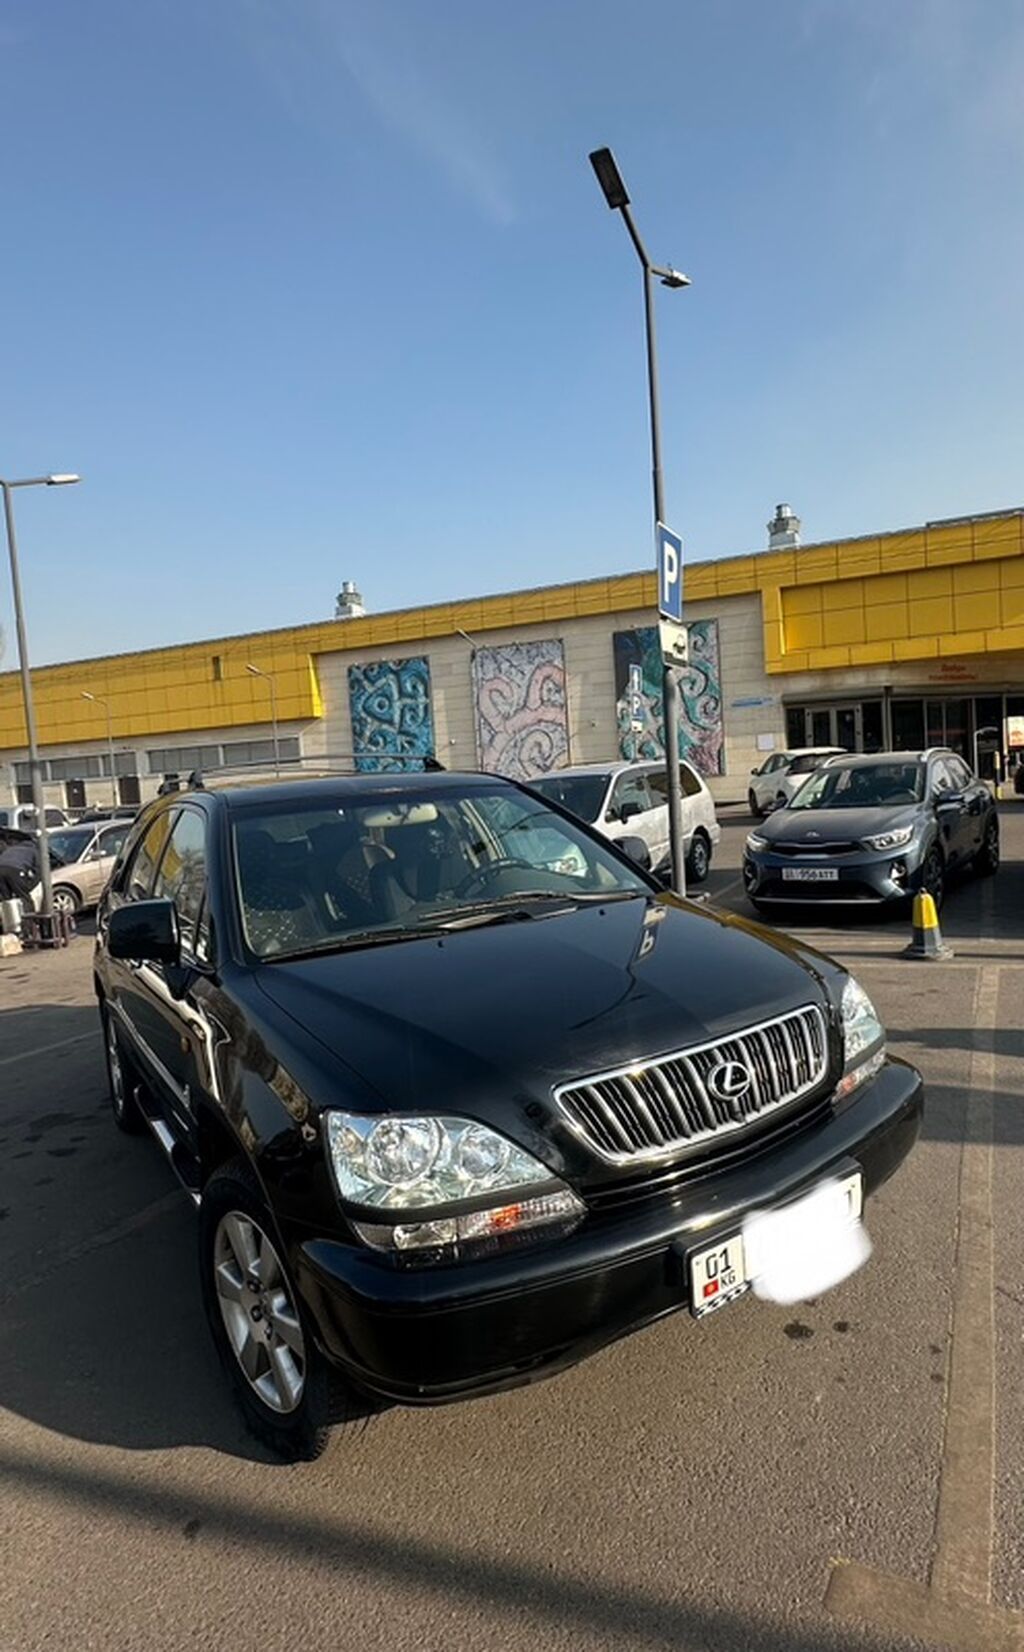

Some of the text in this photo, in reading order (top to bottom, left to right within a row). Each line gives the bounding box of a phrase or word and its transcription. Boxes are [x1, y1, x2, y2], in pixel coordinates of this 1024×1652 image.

[664, 541, 678, 603] P
[632, 695, 641, 715] P
[706, 1248, 731, 1280] 01
[720, 1270, 736, 1289] KG
